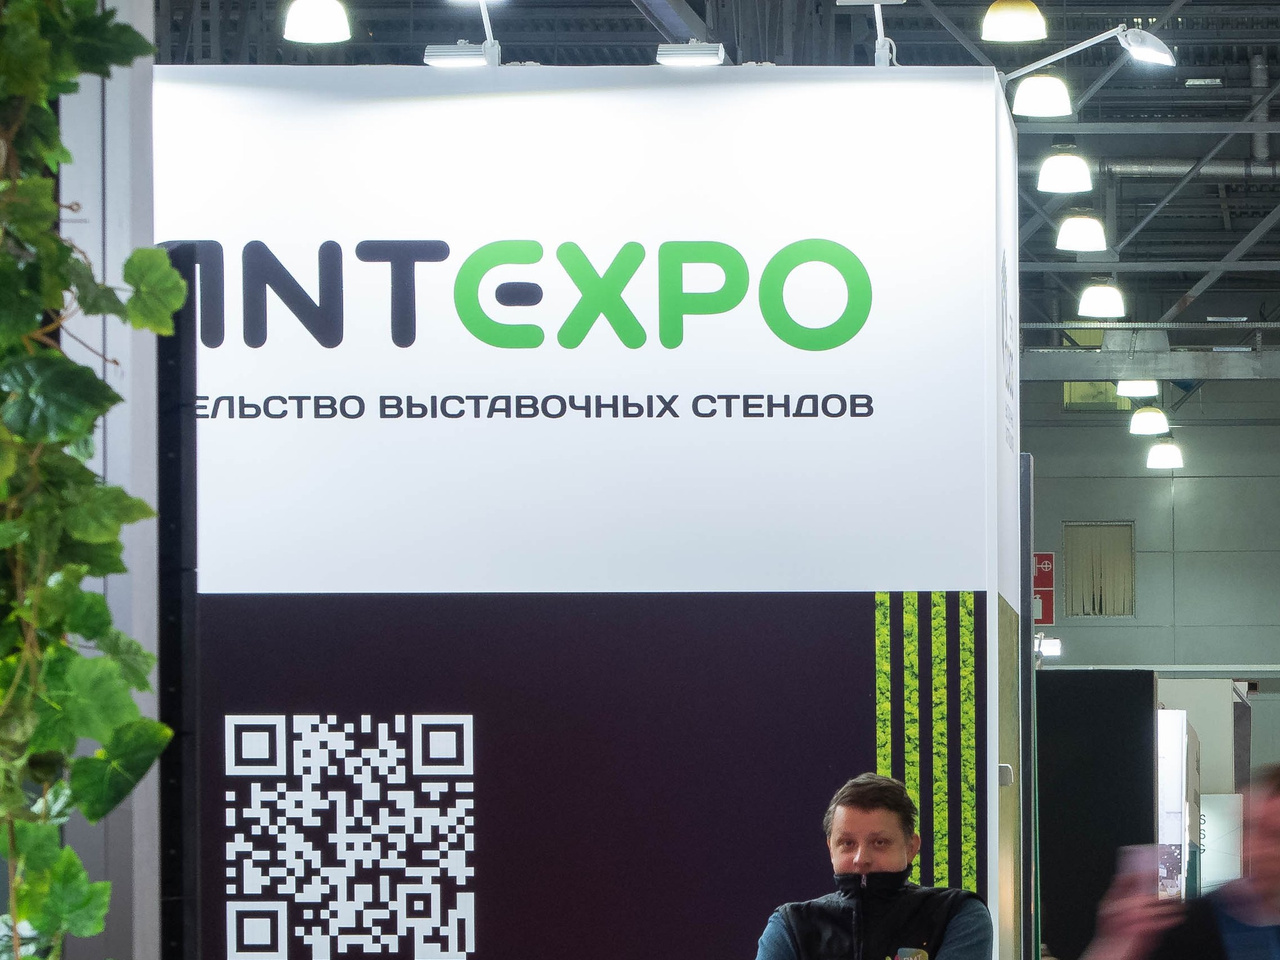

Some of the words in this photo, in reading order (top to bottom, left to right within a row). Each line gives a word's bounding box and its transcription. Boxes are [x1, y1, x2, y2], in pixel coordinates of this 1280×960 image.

[196, 395, 366, 419] ЕЛЬСТВО
[380, 395, 680, 420] ВЫСТАВОЧНЫХ
[692, 394, 874, 419] СТЕНДОВ
